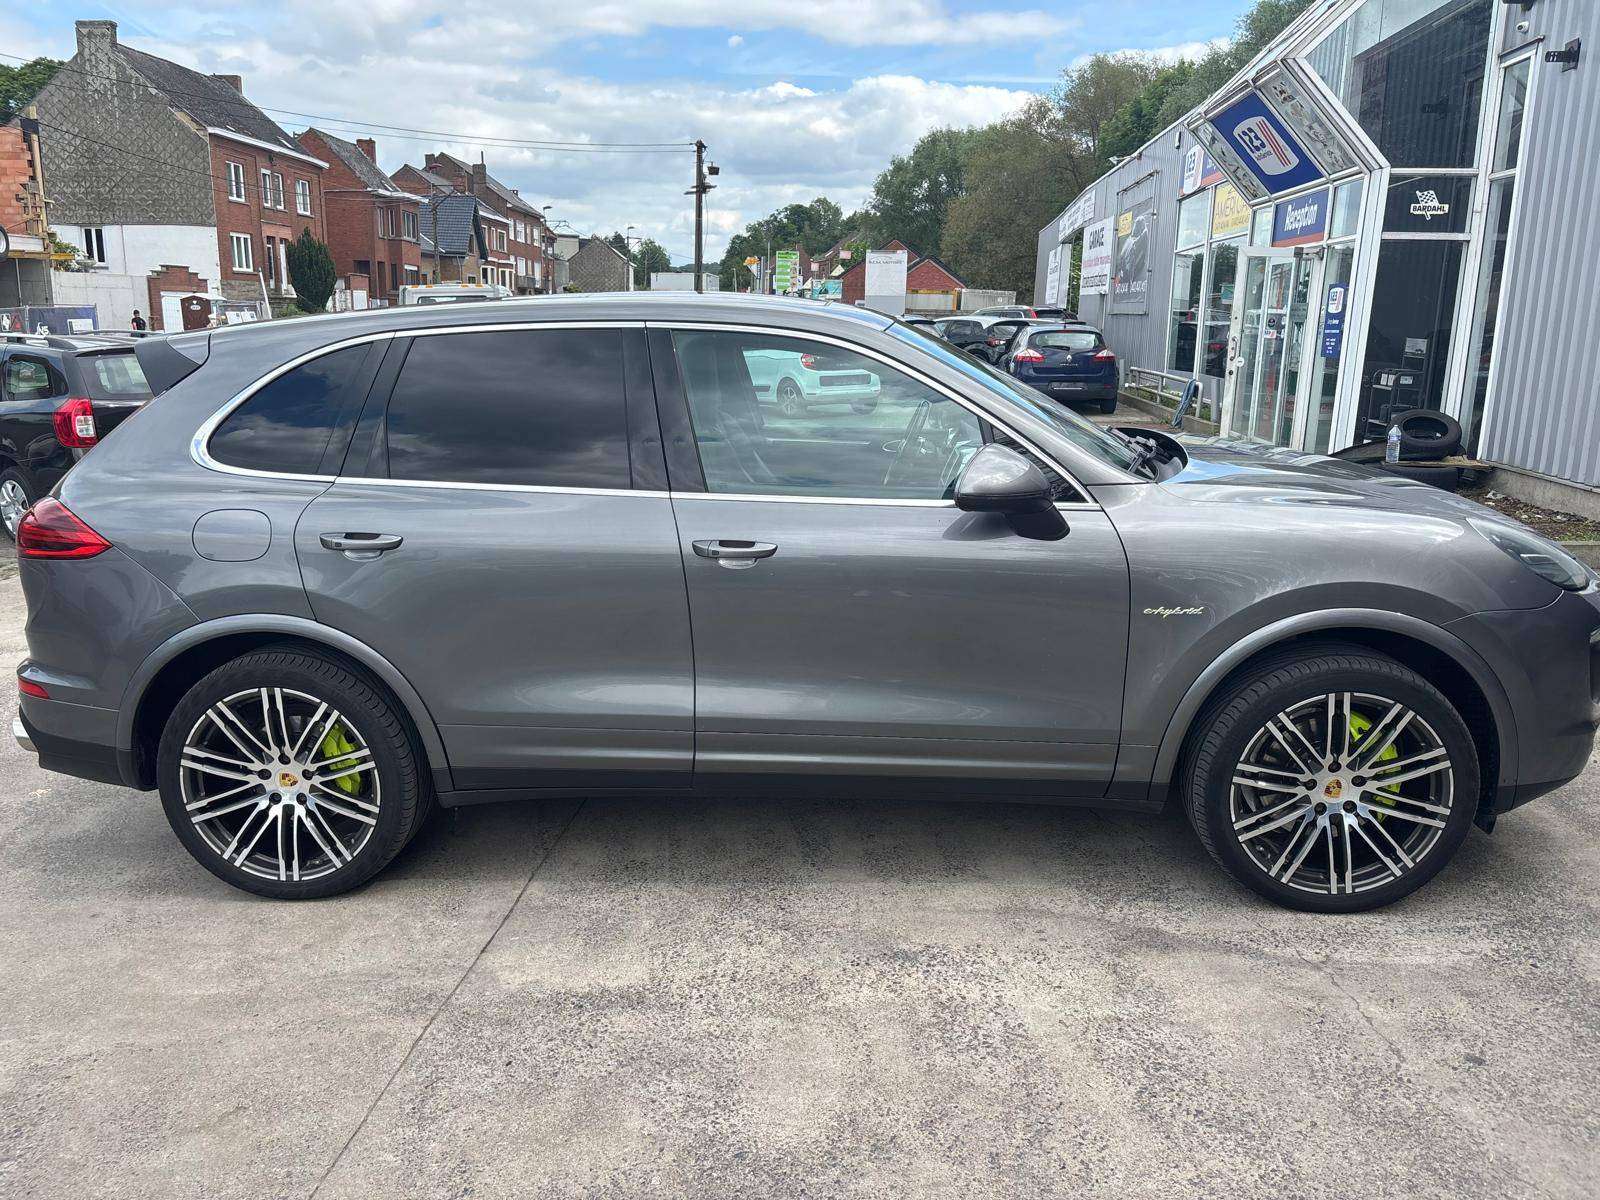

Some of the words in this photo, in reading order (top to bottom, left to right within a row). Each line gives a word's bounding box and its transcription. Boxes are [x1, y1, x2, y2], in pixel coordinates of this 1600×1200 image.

[1237, 126, 1267, 154] 123
[1284, 198, 1319, 235] Réception
[1412, 205, 1447, 213] BARDAHL
